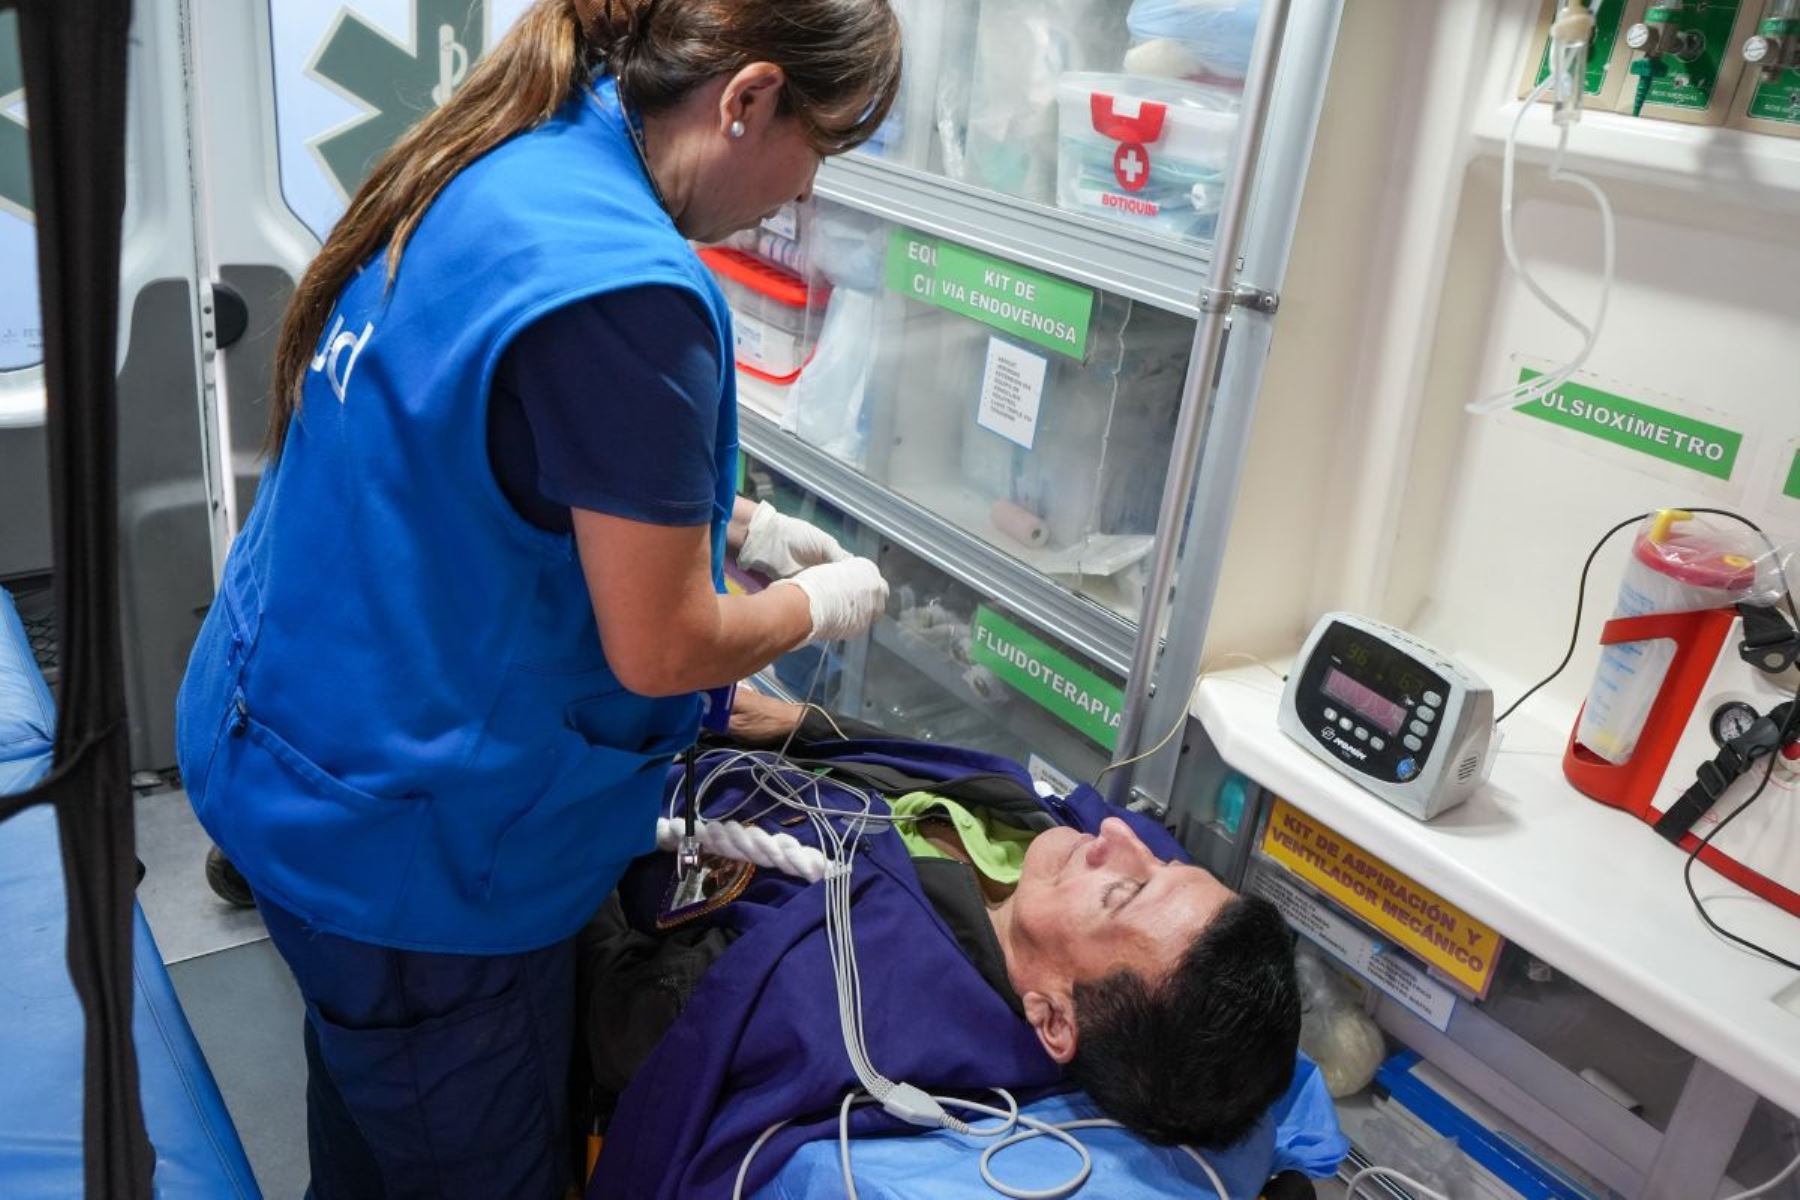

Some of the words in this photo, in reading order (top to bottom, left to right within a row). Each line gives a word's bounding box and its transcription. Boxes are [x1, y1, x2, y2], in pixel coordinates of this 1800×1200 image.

[942, 279, 966, 302] VIA
[969, 290, 1077, 344] ENDOVENOSA
[984, 269, 1011, 291] KIT
[1014, 281, 1036, 302] DE
[1534, 389, 1724, 462] ULSIOXÍMETRO
[976, 625, 1122, 729] FLUIDOTERAPIA
[1271, 825, 1379, 907] VENTILADOR
[1381, 898, 1484, 973] MECÁNICO
[1283, 813, 1313, 841] KIT
[1315, 834, 1340, 858] DE
[1341, 852, 1457, 933] ASPIRACIÓN
[1467, 927, 1483, 946] Y
